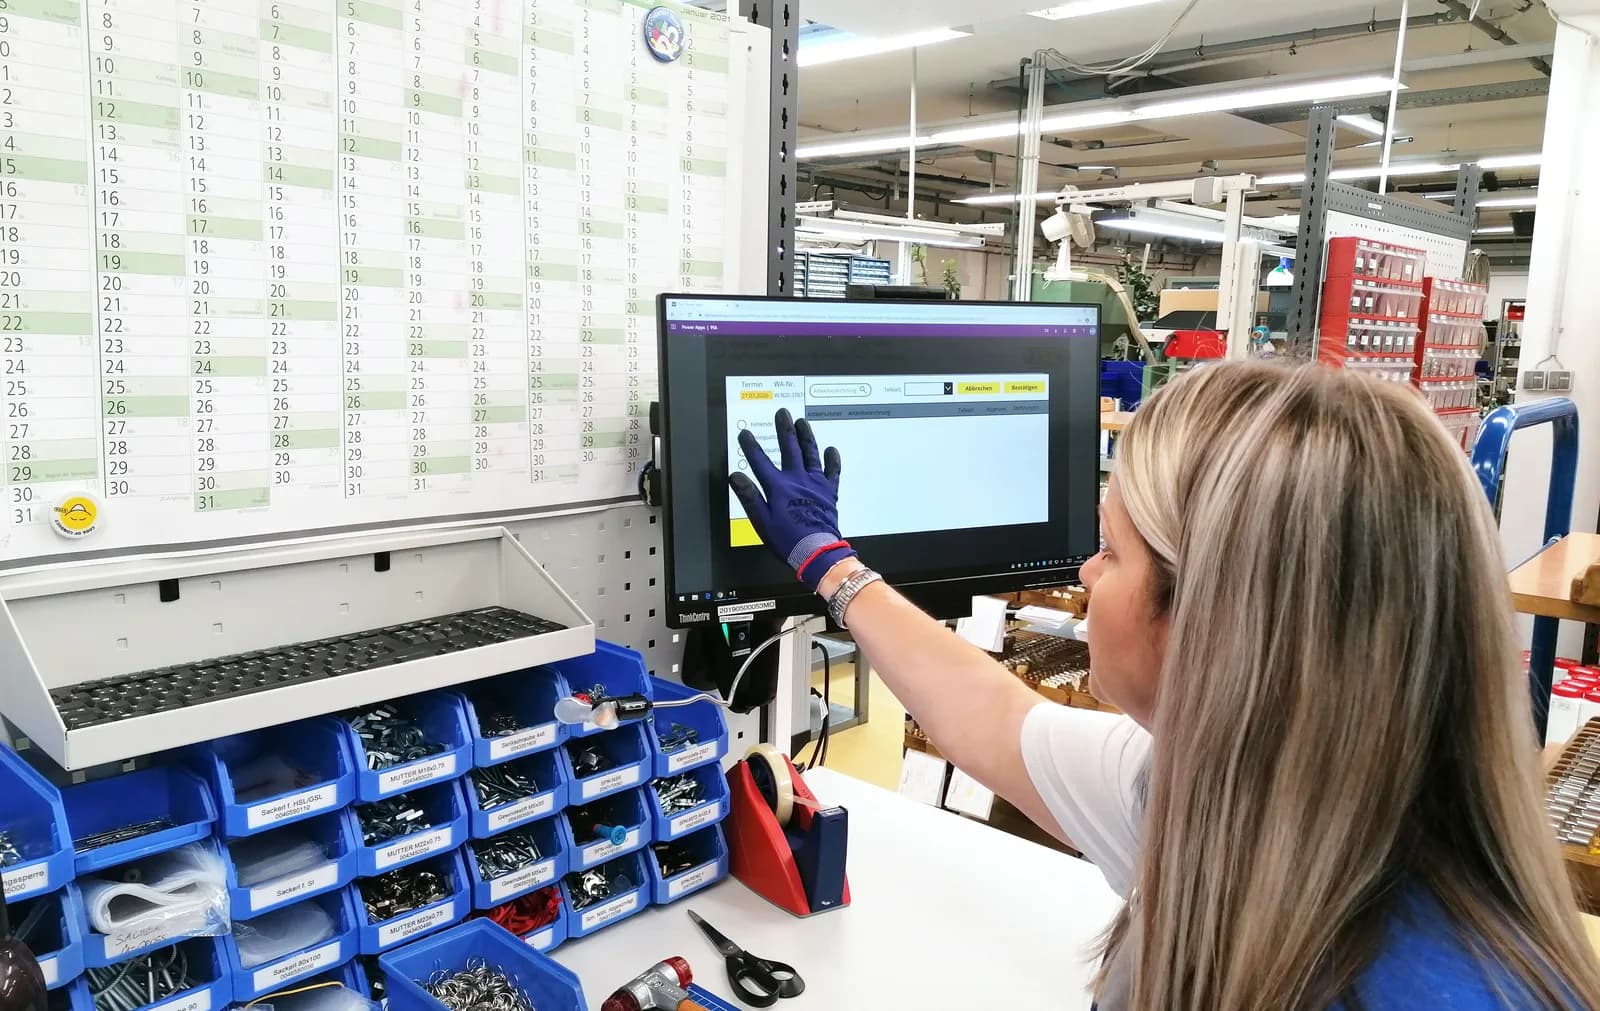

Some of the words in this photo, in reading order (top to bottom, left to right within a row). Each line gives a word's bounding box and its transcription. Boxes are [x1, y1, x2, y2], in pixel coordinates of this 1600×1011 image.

[102, 12, 112, 29] 8
[192, 8, 200, 23] 7
[710, 13, 731, 22] 2021
[272, 25, 279, 40] 7
[348, 22, 355, 36] 6
[414, 18, 421, 32] 5
[103, 35, 113, 51] 9
[96, 56, 114, 74] 10
[193, 51, 202, 66] 9
[473, 52, 480, 64] 6
[688, 54, 692, 65] 3
[272, 66, 281, 80] 9
[348, 61, 356, 75] 8
[530, 66, 536, 78] 6
[186, 72, 203, 88] 10
[267, 86, 281, 101] 10
[413, 94, 420, 106] 9
[188, 114, 204, 130] 12
[98, 124, 116, 141] 13
[343, 138, 356, 153] 12
[100, 146, 118, 162] 14
[268, 146, 282, 161] 13
[408, 148, 419, 162] 12
[190, 156, 206, 172] 14
[683, 160, 691, 171] 10
[268, 166, 283, 181] 14
[343, 176, 356, 190] 14
[468, 175, 480, 188] 13
[101, 190, 119, 206] 16
[627, 197, 636, 209] 13
[191, 198, 207, 214] 16
[268, 206, 283, 221] 16
[408, 203, 420, 216] 15
[101, 211, 119, 227] 17
[192, 219, 207, 234] 17
[344, 214, 357, 227] 16
[408, 220, 421, 234] 16
[470, 227, 482, 239] 16
[582, 222, 591, 234] 15
[102, 233, 120, 249] 18
[0, 248, 20, 265] 19
[270, 245, 285, 260] 18
[103, 254, 121, 270] 19
[193, 260, 209, 275] 19
[409, 256, 421, 269] 18
[682, 262, 690, 272] 17
[344, 269, 358, 283] 19
[529, 265, 540, 277] 18
[0, 271, 21, 287] 20
[102, 275, 122, 291] 20
[1, 293, 19, 309] 21
[103, 296, 120, 312] 21
[193, 300, 208, 315] 21
[471, 294, 484, 307] 20
[271, 303, 284, 317] 21
[345, 306, 357, 319] 21
[410, 308, 421, 321] 21
[2, 315, 23, 331] 22
[104, 317, 123, 333] 22
[530, 329, 541, 341] 22
[582, 330, 592, 343] 22
[4, 337, 23, 353] 23
[104, 338, 123, 354] 23
[194, 340, 211, 355] 23
[272, 341, 287, 355] 23
[346, 342, 359, 355] 23
[410, 343, 423, 356] 23
[472, 344, 485, 357] 23
[5, 359, 25, 374] 24
[105, 359, 125, 374] 24
[195, 360, 213, 375] 24
[6, 380, 27, 396] 25
[106, 380, 125, 395] 25
[272, 378, 288, 392] 25
[411, 377, 425, 390] 25
[531, 376, 542, 389] 25
[106, 400, 126, 415] 26
[196, 399, 213, 414] 26
[346, 395, 361, 409] 26
[8, 402, 28, 418] 26
[474, 409, 487, 422] 27
[628, 404, 639, 417] 27
[107, 420, 126, 435] 27
[274, 415, 289, 430] 27
[628, 419, 640, 430] 28
[9, 423, 29, 439] 27
[347, 430, 362, 444] 28
[412, 428, 426, 441] 28
[108, 440, 128, 455] 28
[197, 438, 214, 452] 28
[582, 436, 594, 448] 29
[11, 445, 31, 461] 28
[533, 454, 544, 466] 30
[582, 450, 593, 462] 30
[109, 460, 128, 475] 29
[413, 461, 427, 474] 30
[475, 458, 488, 470] 30
[12, 466, 32, 482] 29
[274, 470, 290, 485] 30
[109, 480, 129, 495] 30
[198, 476, 215, 491] 30
[348, 483, 361, 496] 31
[13, 486, 32, 503] 30
[198, 495, 214, 510] 31
[14, 507, 32, 524] 31
[678, 612, 710, 623] ThinkCentre
[390, 770, 416, 782] MUTTER
[387, 844, 413, 857] MUTTER
[390, 921, 416, 934] MUTTER
